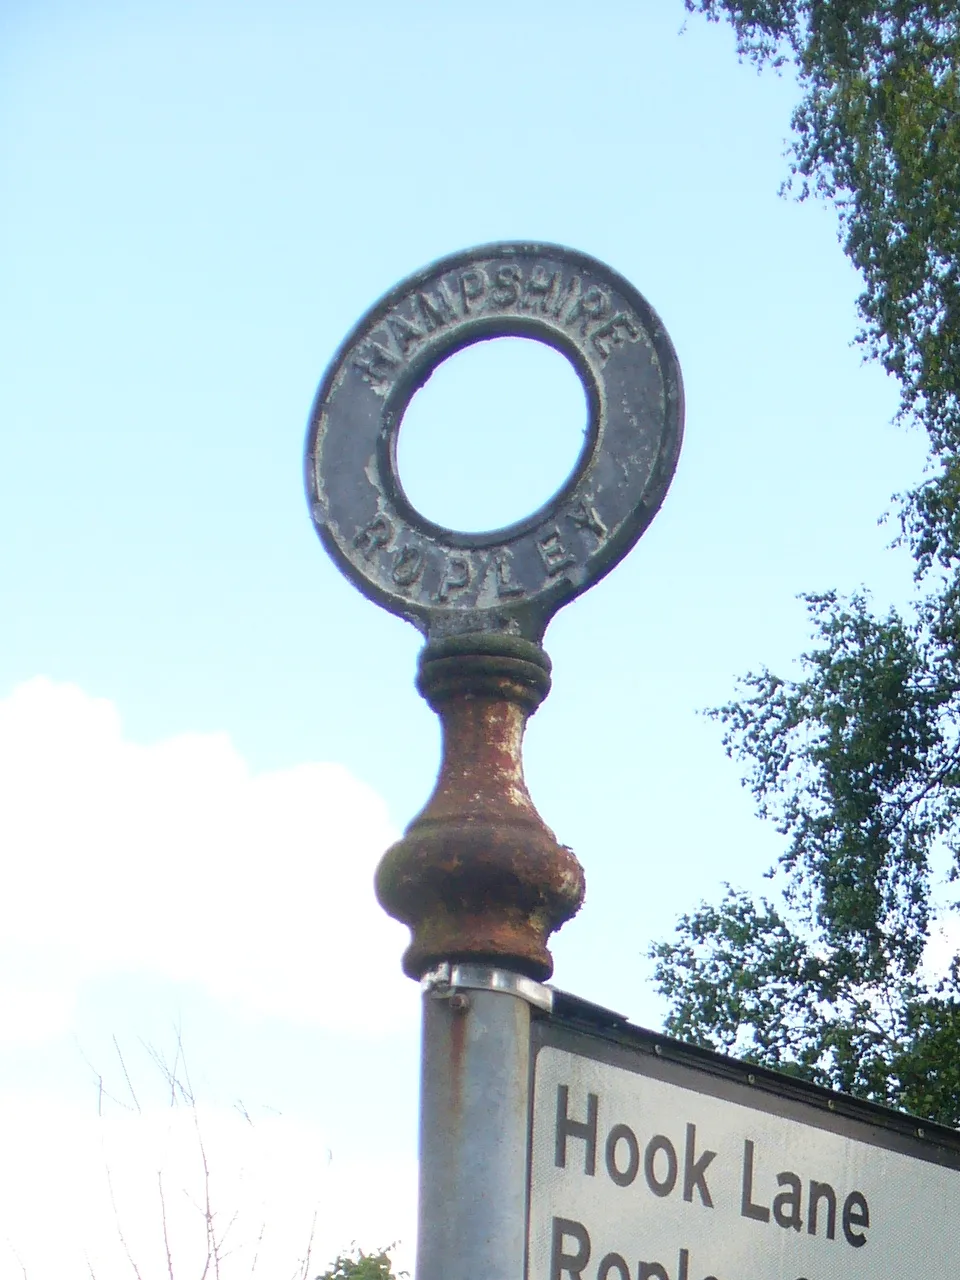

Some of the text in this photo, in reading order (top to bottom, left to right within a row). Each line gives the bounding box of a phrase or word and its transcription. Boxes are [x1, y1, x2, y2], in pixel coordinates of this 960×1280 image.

[354, 264, 645, 397] HAMPSHIRE
[352, 492, 608, 603] ROPLEY
[554, 1083, 871, 1248] Hook Lane
